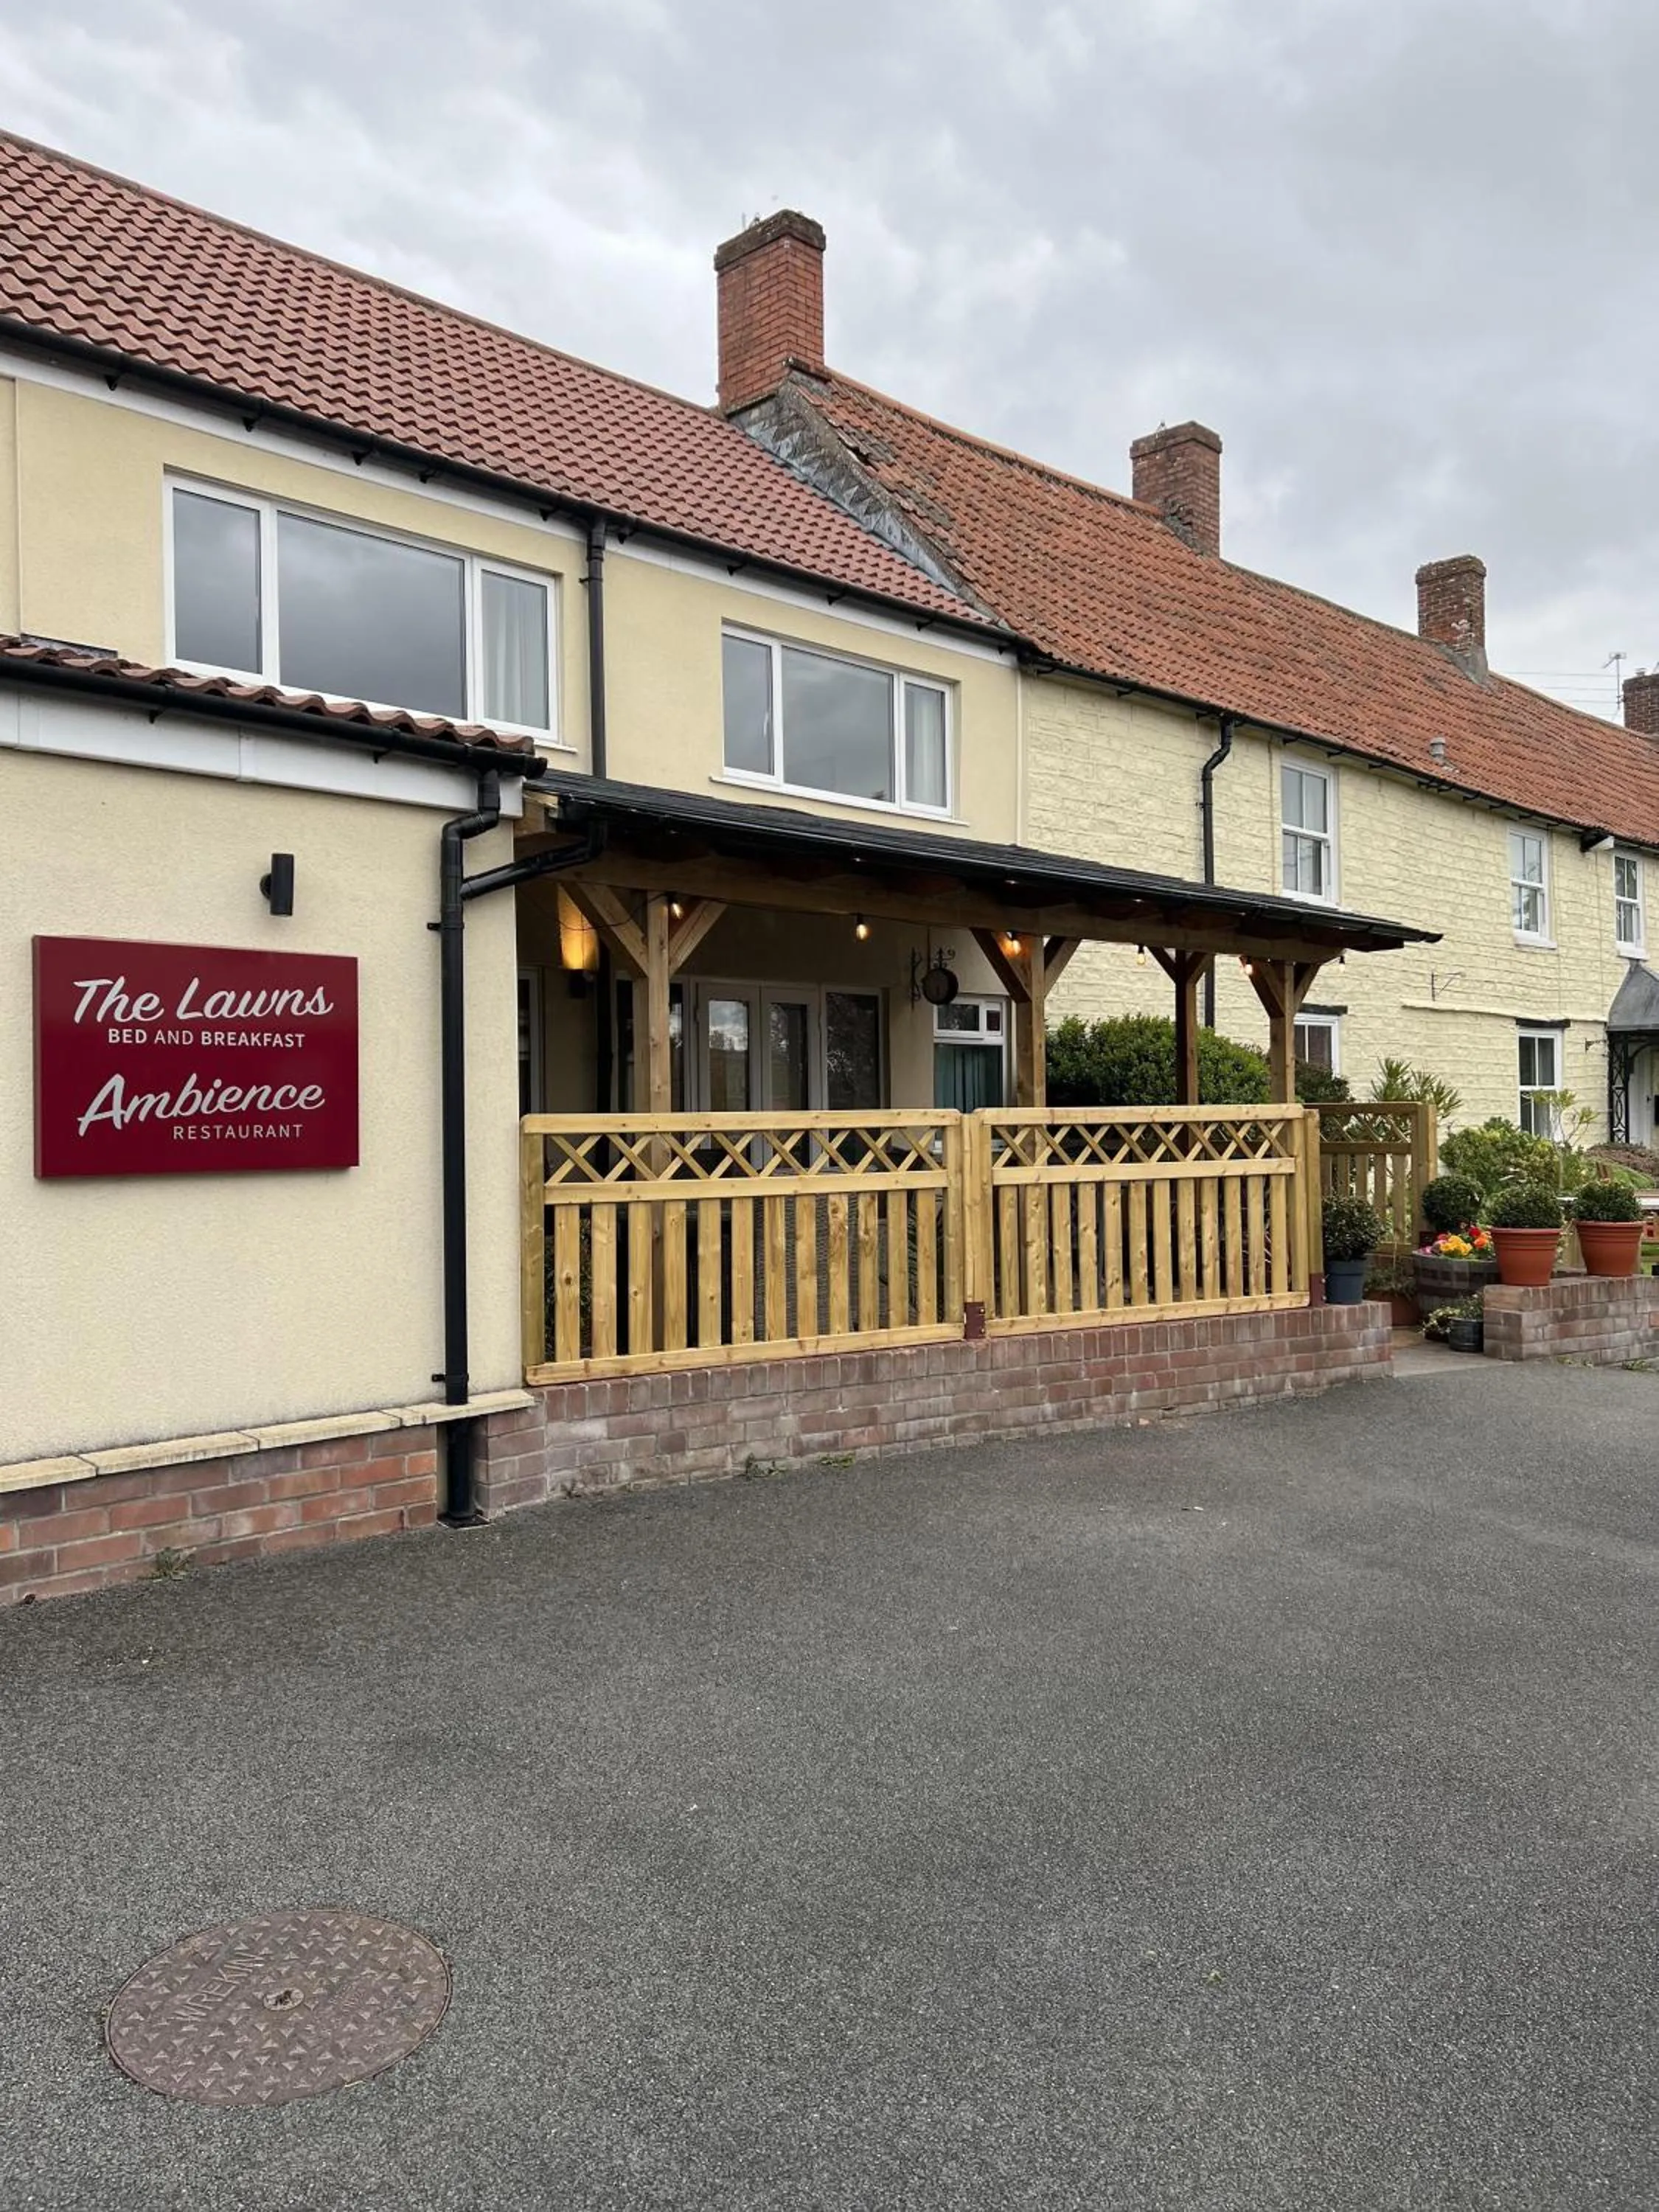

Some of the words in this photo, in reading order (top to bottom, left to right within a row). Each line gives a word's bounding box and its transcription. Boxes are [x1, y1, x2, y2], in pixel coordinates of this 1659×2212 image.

[73, 975, 164, 1024] The
[176, 977, 334, 1020] Lawns
[108, 1029, 147, 1044] BED
[154, 1029, 194, 1046] AND
[201, 1032, 306, 1048] BREAKFAST
[77, 1073, 325, 1137] Ambience
[173, 1124, 303, 1140] RESTAURANT
[167, 1952, 264, 2022] WREKIN
